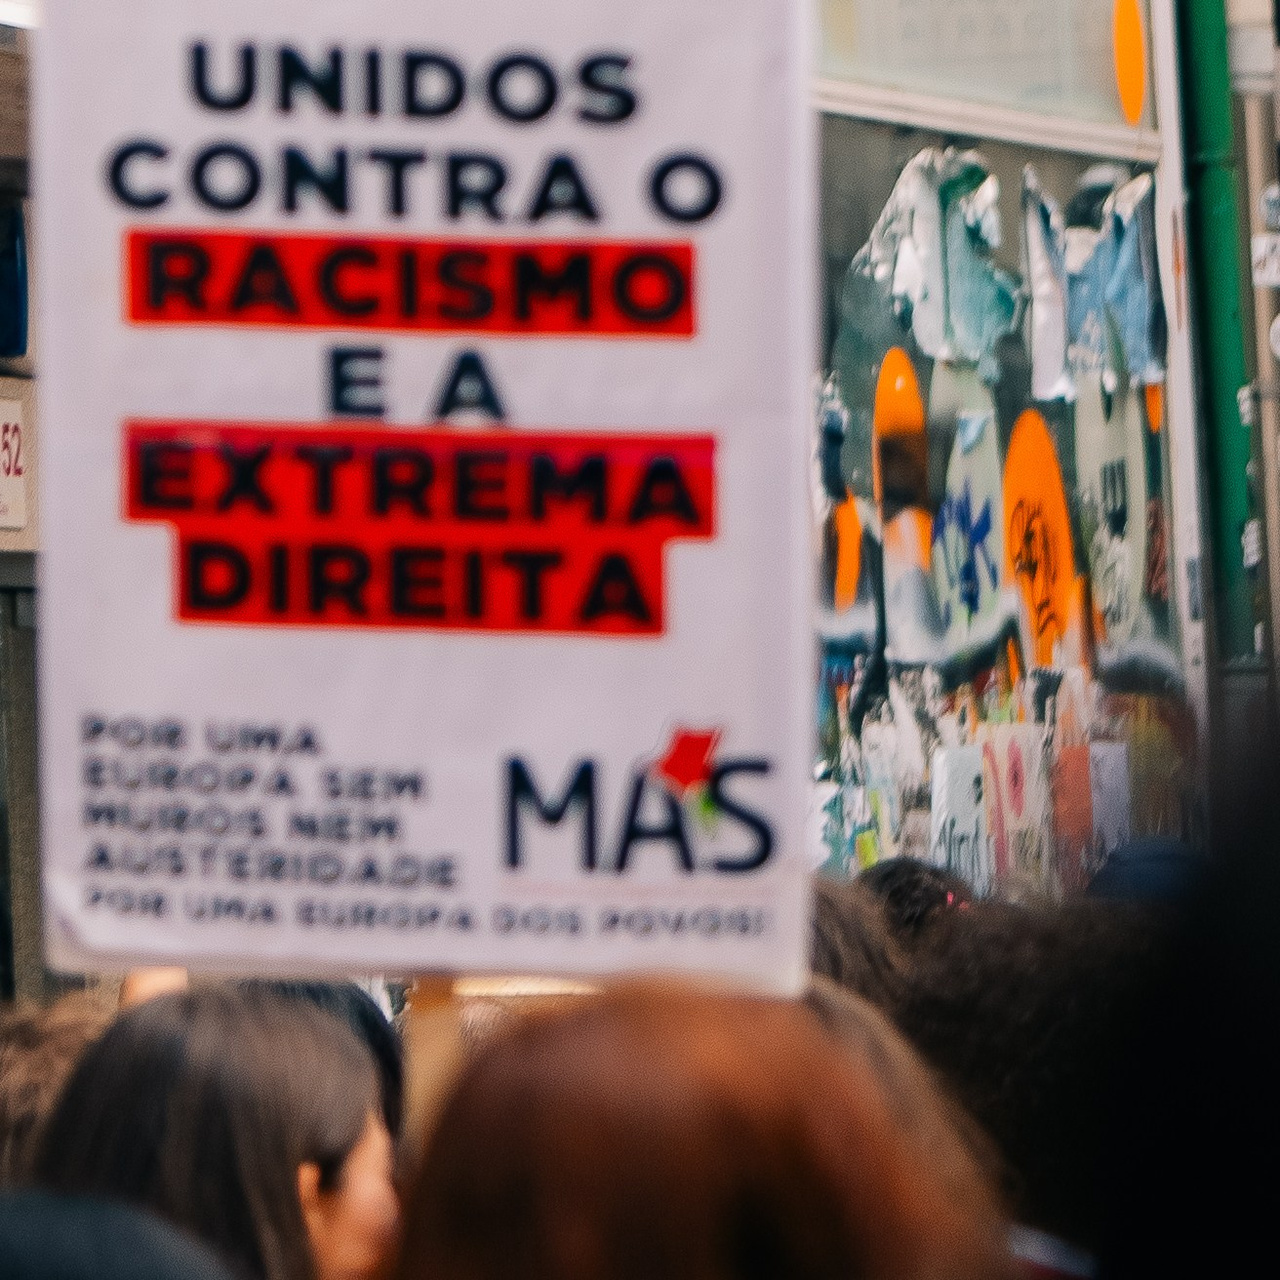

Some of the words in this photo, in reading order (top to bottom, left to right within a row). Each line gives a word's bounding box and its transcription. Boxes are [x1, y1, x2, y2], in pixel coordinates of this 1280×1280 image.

[189, 41, 639, 125] UNIDOS
[109, 140, 601, 224] CONTRA
[647, 153, 723, 225] O
[143, 243, 686, 326] RACISMO
[327, 346, 386, 420] E
[432, 349, 507, 422] A
[135, 442, 702, 526] EXTREMA
[183, 541, 652, 625] DIREITA
[82, 717, 183, 751] POR
[204, 721, 320, 756] UMA
[82, 756, 294, 796] EUROPA
[324, 768, 425, 802] SEM
[504, 753, 777, 876] MAS
[82, 803, 266, 838] MUROS
[289, 811, 399, 842] NEM
[86, 844, 455, 888] AUSTERIDADE
